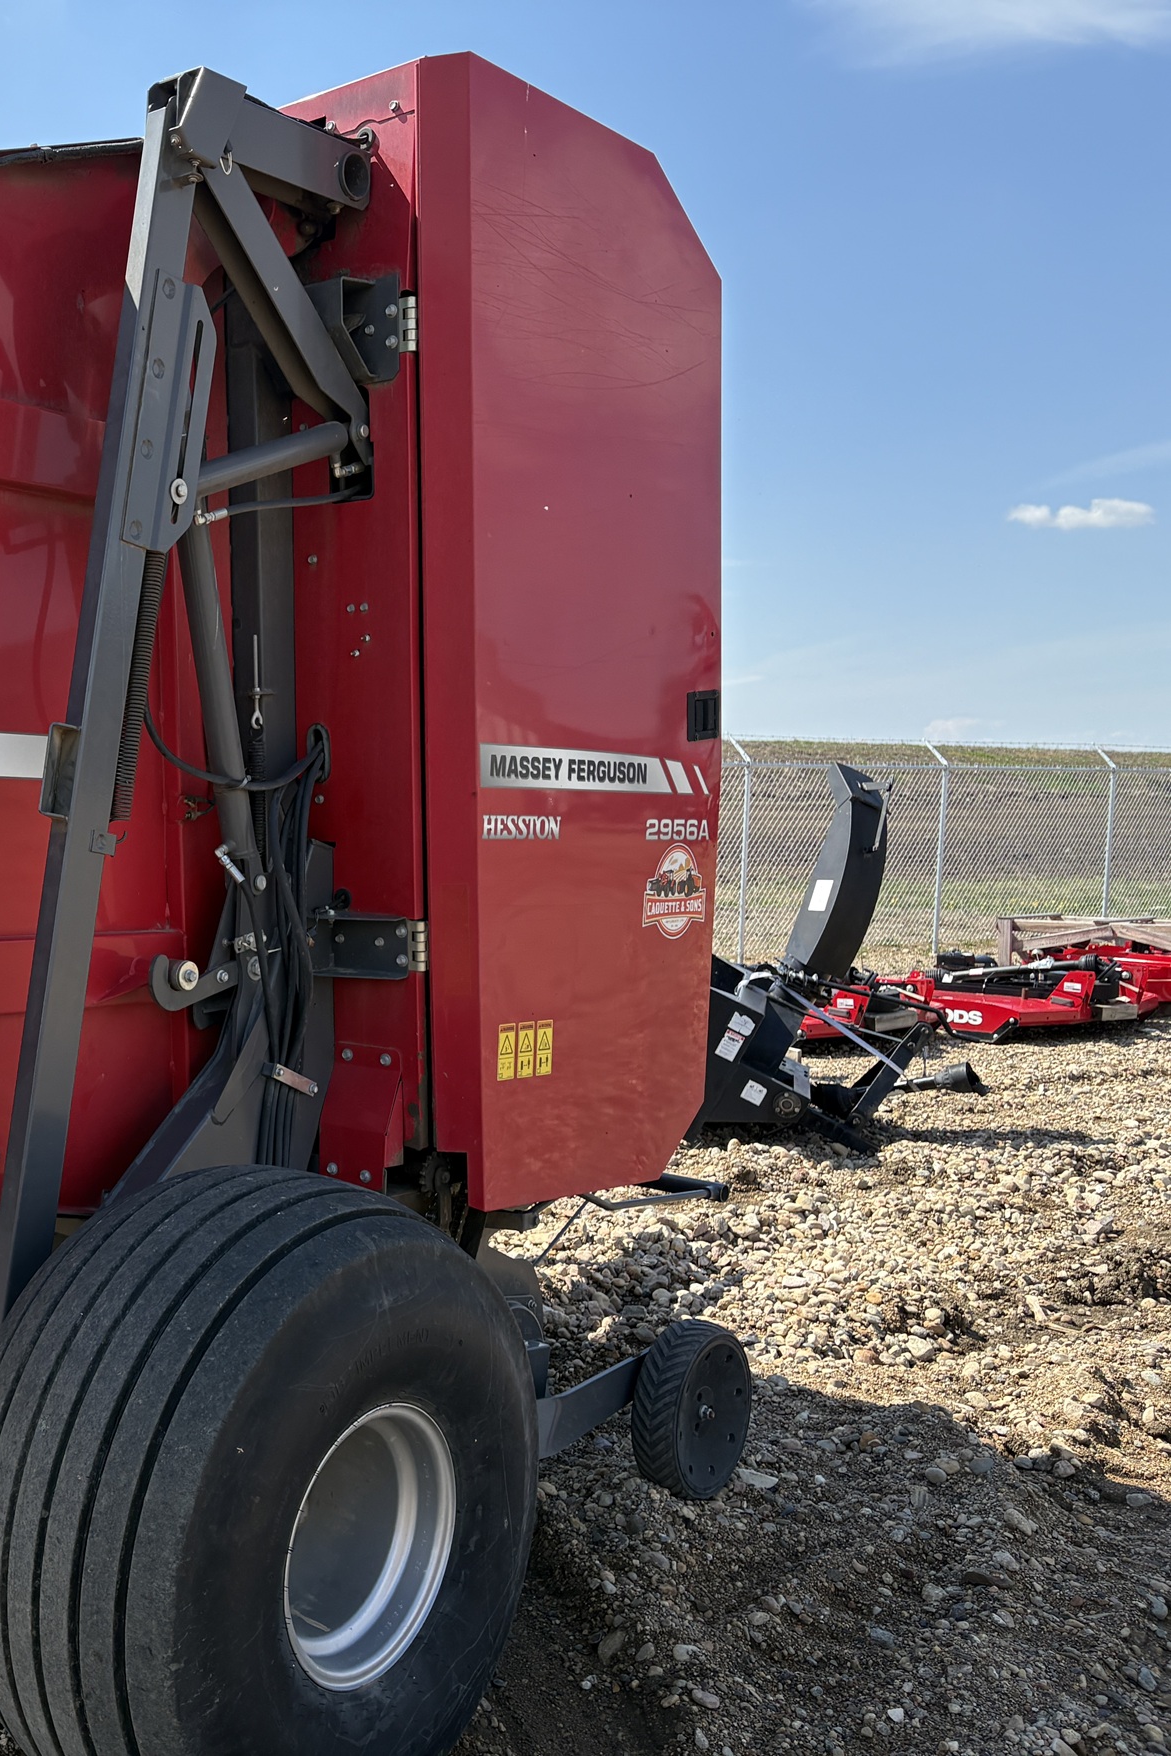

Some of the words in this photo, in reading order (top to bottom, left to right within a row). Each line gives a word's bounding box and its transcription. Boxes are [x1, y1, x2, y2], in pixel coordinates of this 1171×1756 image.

[490, 754, 563, 781] MASSEY
[567, 758, 648, 784] FERGUSON
[482, 815, 561, 840] HESSTON
[645, 819, 709, 840] 2956A
[647, 901, 680, 916] CAOUETTE
[681, 901, 685, 912] &
[686, 898, 702, 912] SONS
